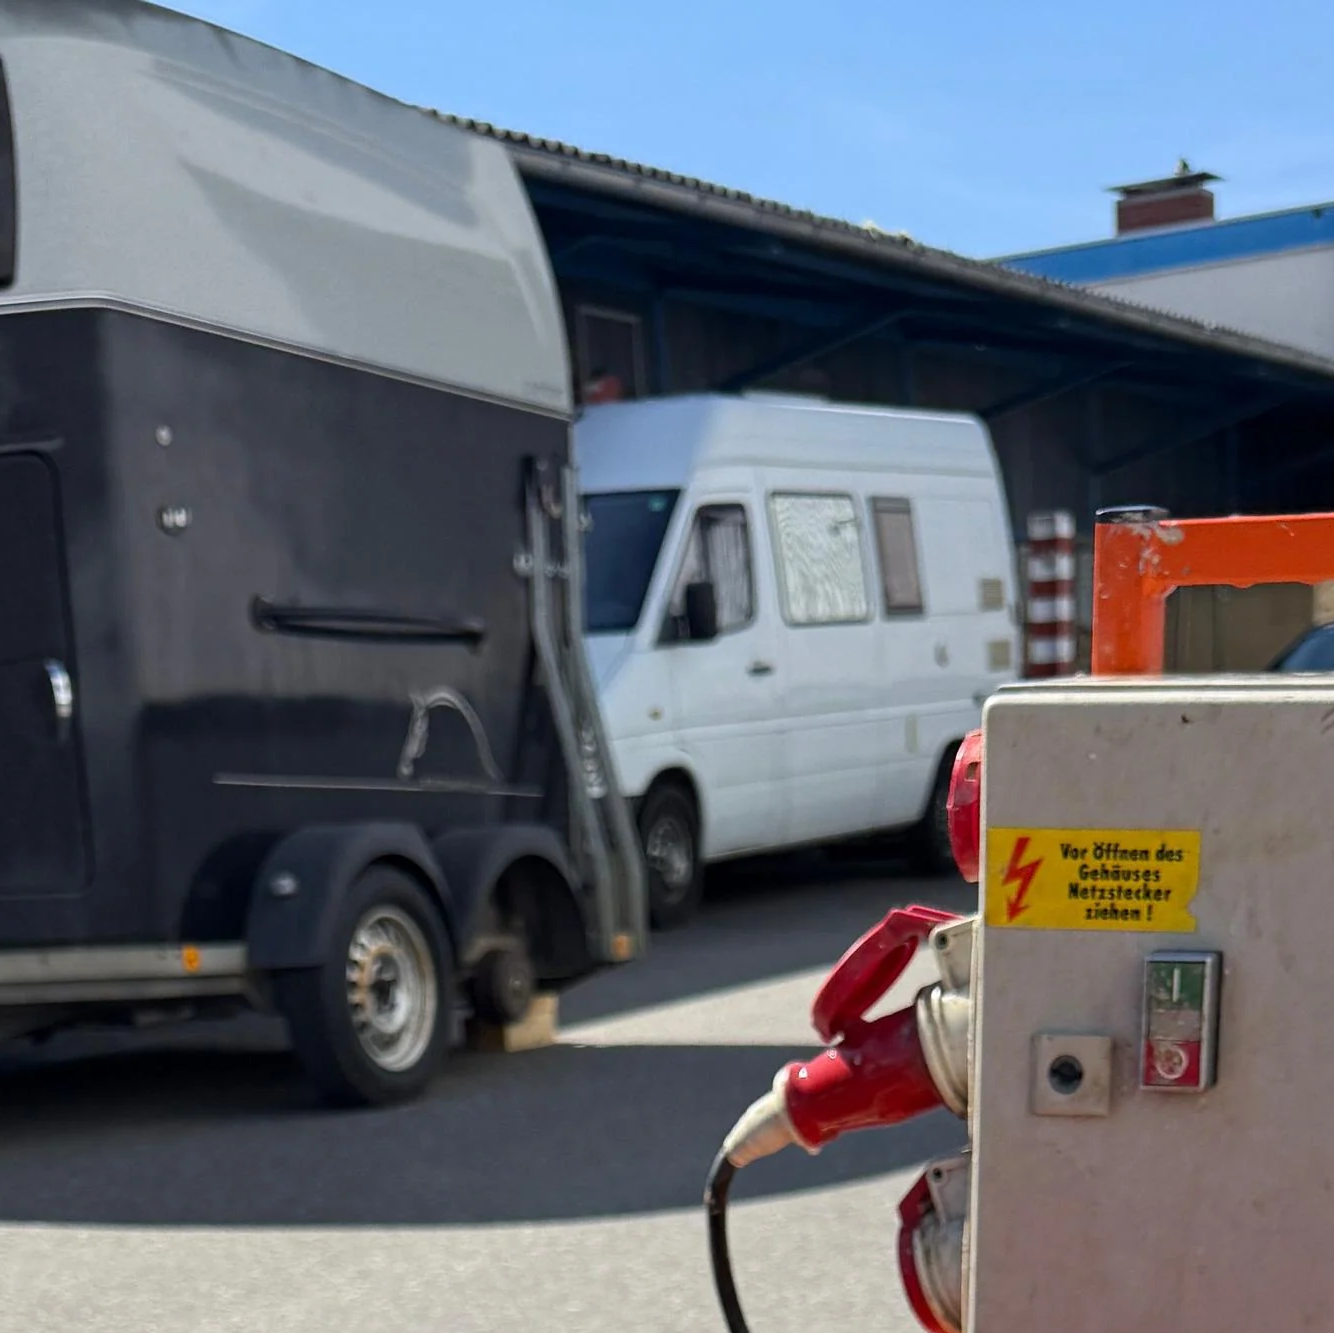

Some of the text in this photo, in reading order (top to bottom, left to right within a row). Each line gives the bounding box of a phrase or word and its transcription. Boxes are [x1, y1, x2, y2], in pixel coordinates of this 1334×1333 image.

[1060, 841, 1184, 862] Vor Öffnen des
[1079, 863, 1161, 882] Gehäuses
[1068, 882, 1171, 901] Netzstecker
